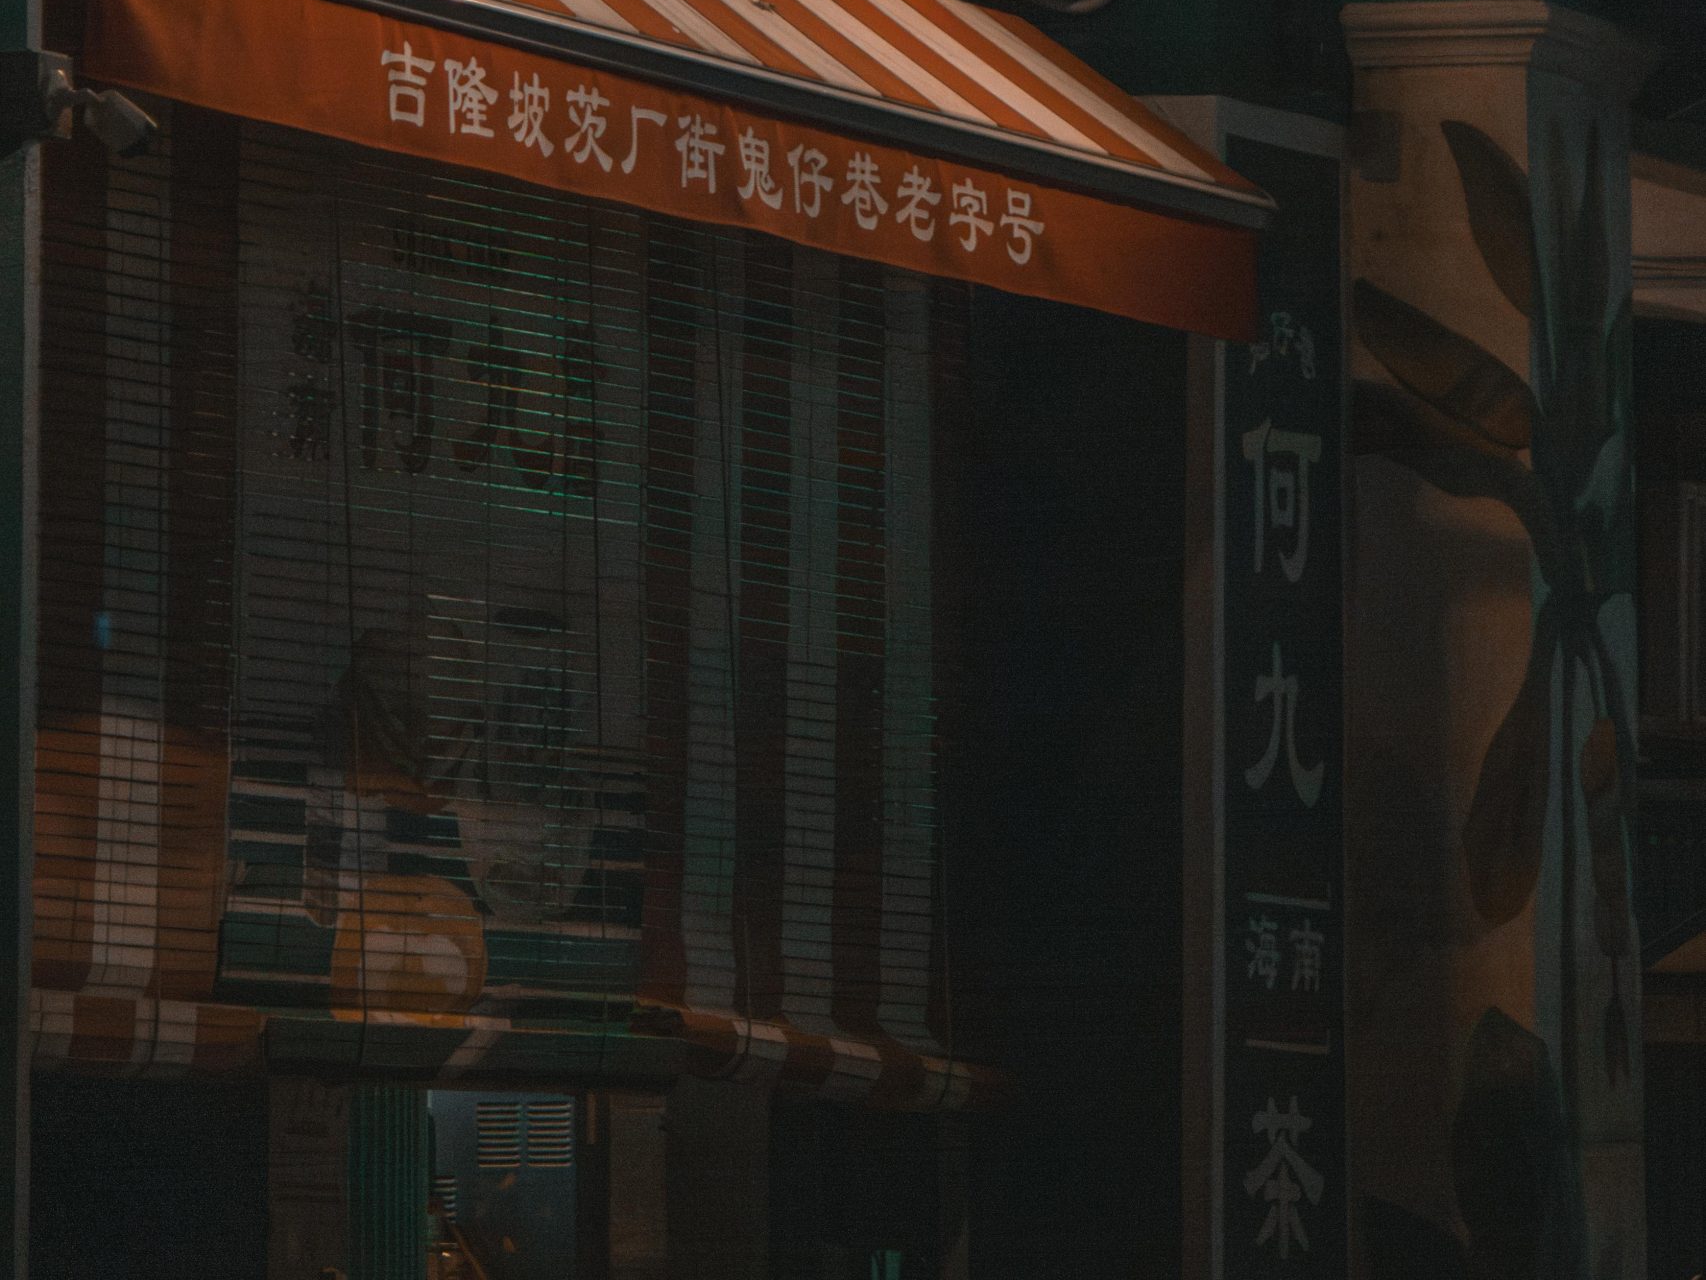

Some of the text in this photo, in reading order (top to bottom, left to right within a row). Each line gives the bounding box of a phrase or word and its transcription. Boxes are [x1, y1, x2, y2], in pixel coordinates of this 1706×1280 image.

[379, 40, 1046, 266] 吉隆坡茨厂街鬼仔巷老字号
